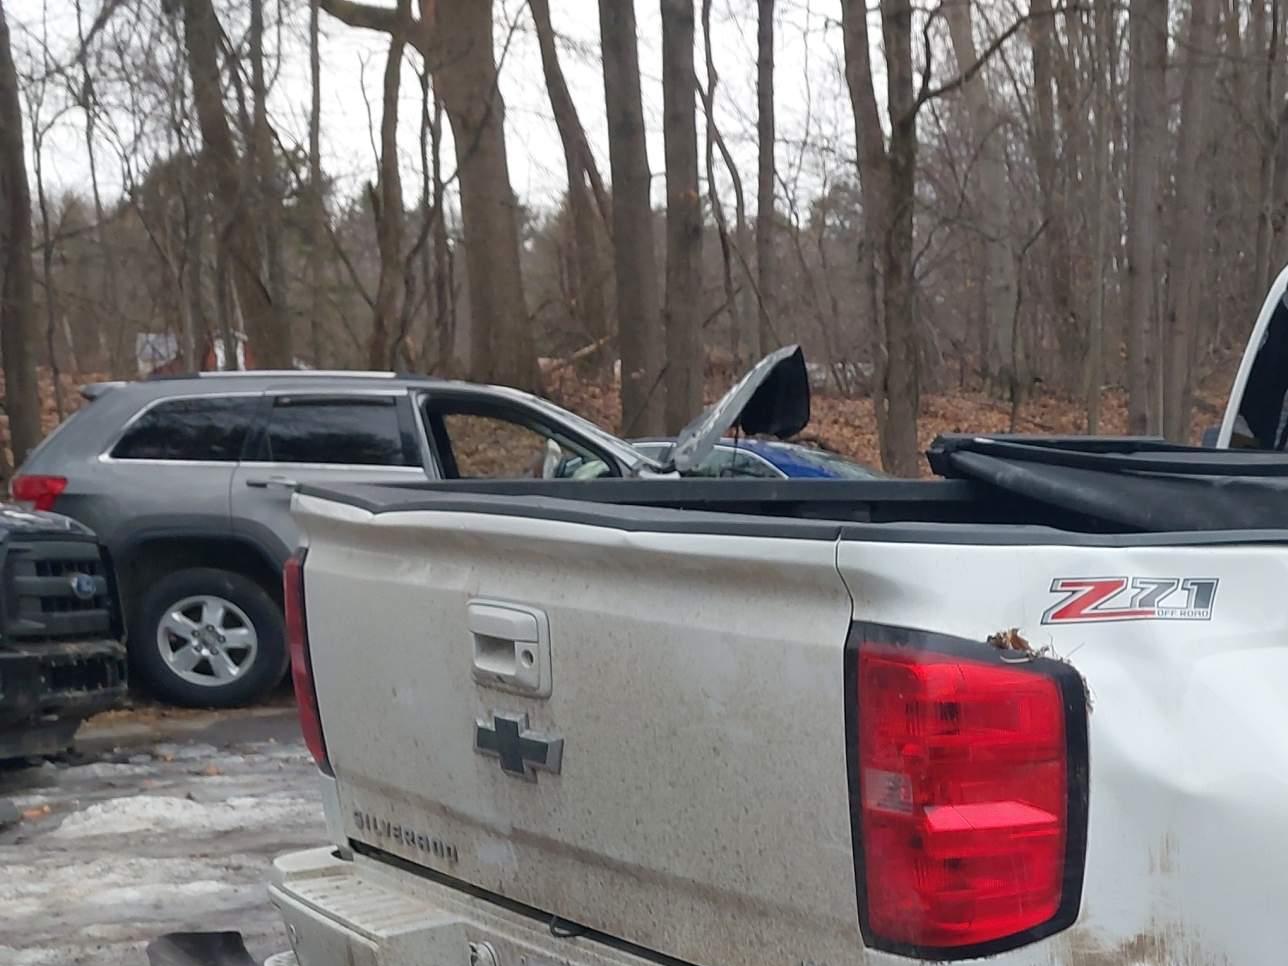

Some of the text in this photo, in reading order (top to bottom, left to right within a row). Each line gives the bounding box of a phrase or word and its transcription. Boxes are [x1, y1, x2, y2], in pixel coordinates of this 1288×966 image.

[1040, 576, 1220, 625] Z71
[1157, 609, 1209, 617] OFF ROAD
